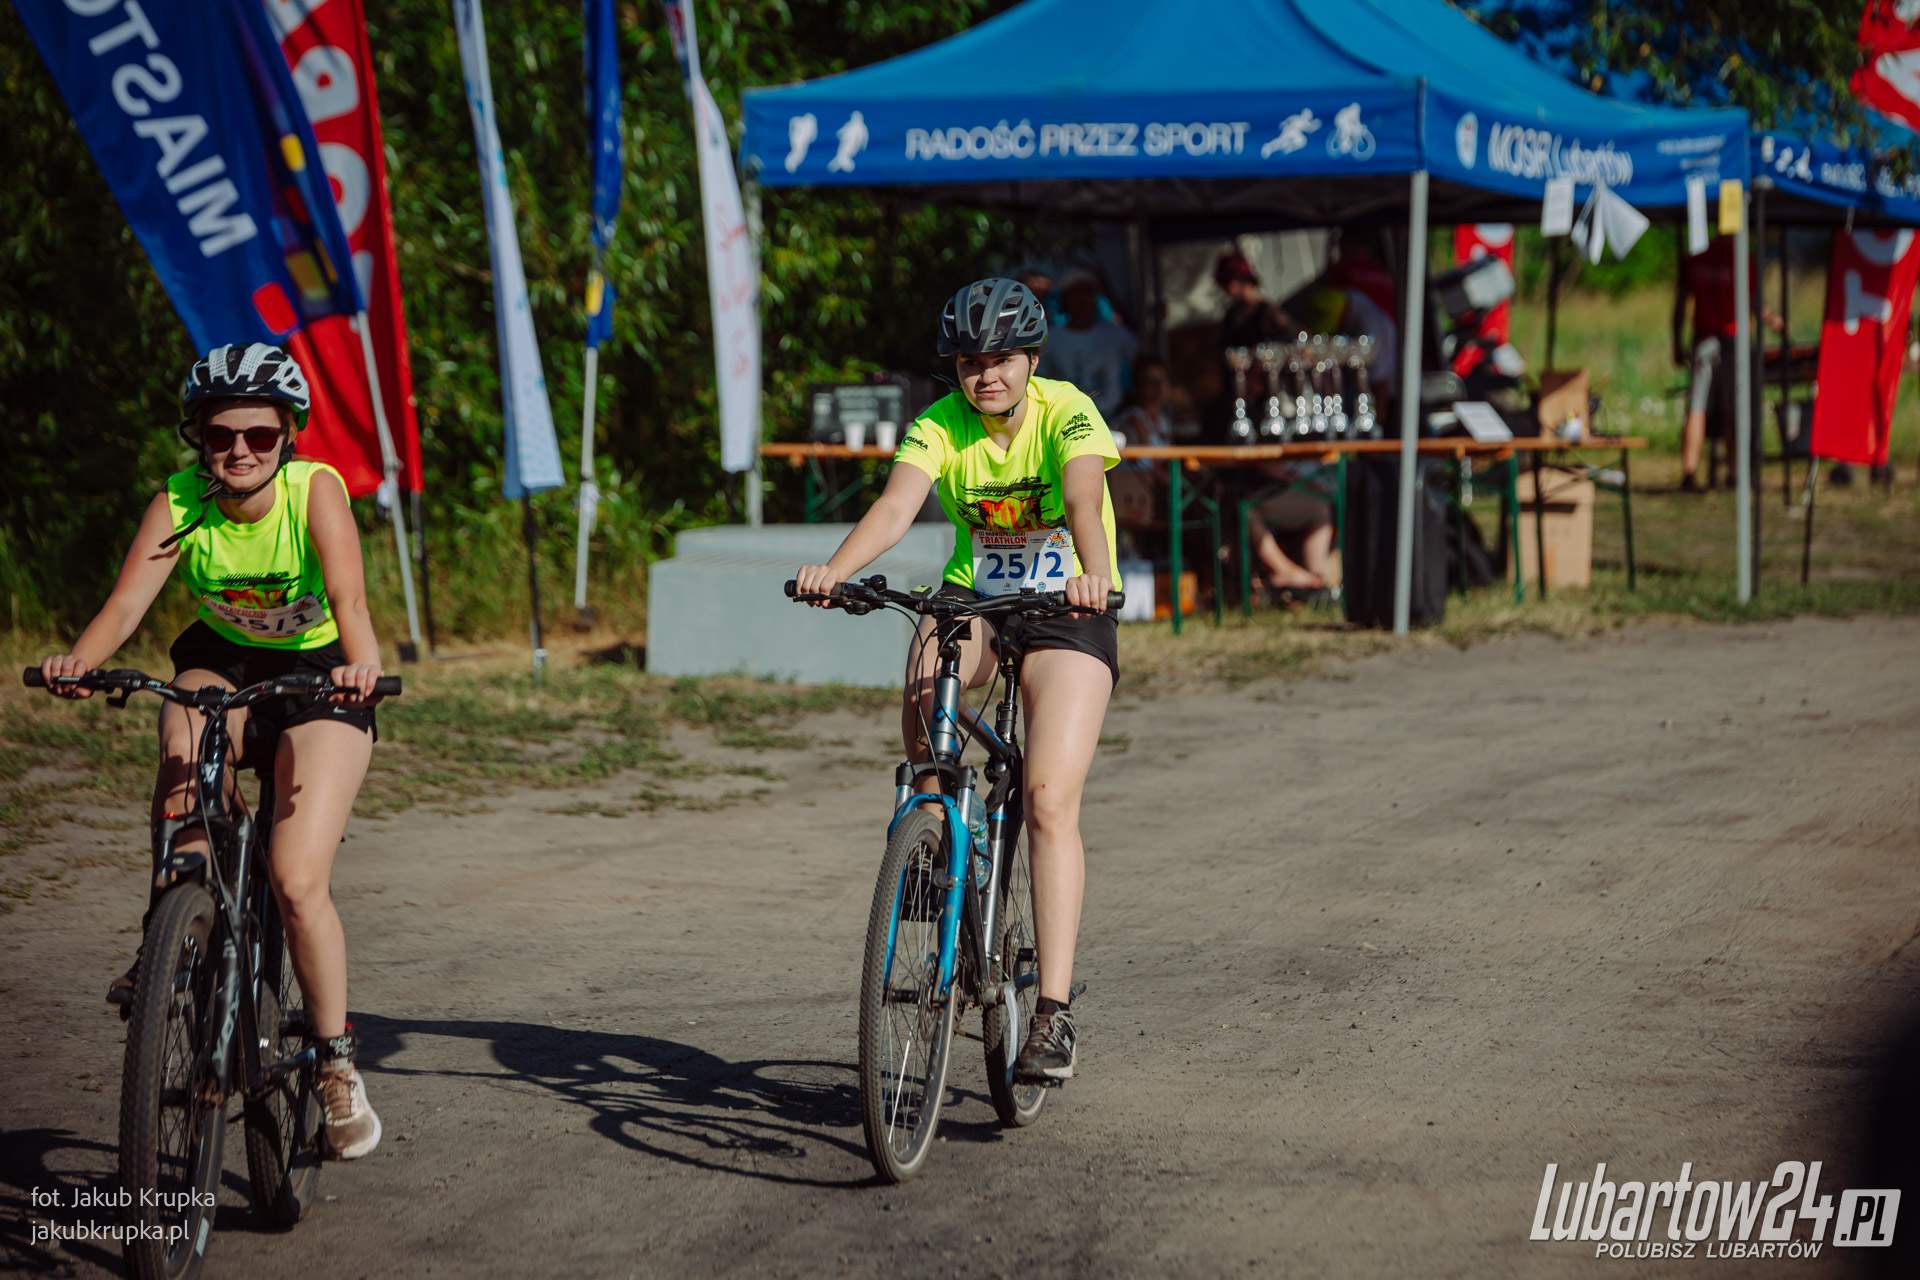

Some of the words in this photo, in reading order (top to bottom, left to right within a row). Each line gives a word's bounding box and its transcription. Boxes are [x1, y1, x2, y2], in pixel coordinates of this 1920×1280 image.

[905, 118, 1036, 160] RADOŚĆ
[1040, 122, 1139, 157] PRZEZ
[1143, 121, 1250, 156] SPORT
[979, 536, 1028, 545] TRIATHLON
[986, 551, 1064, 580] 25/2
